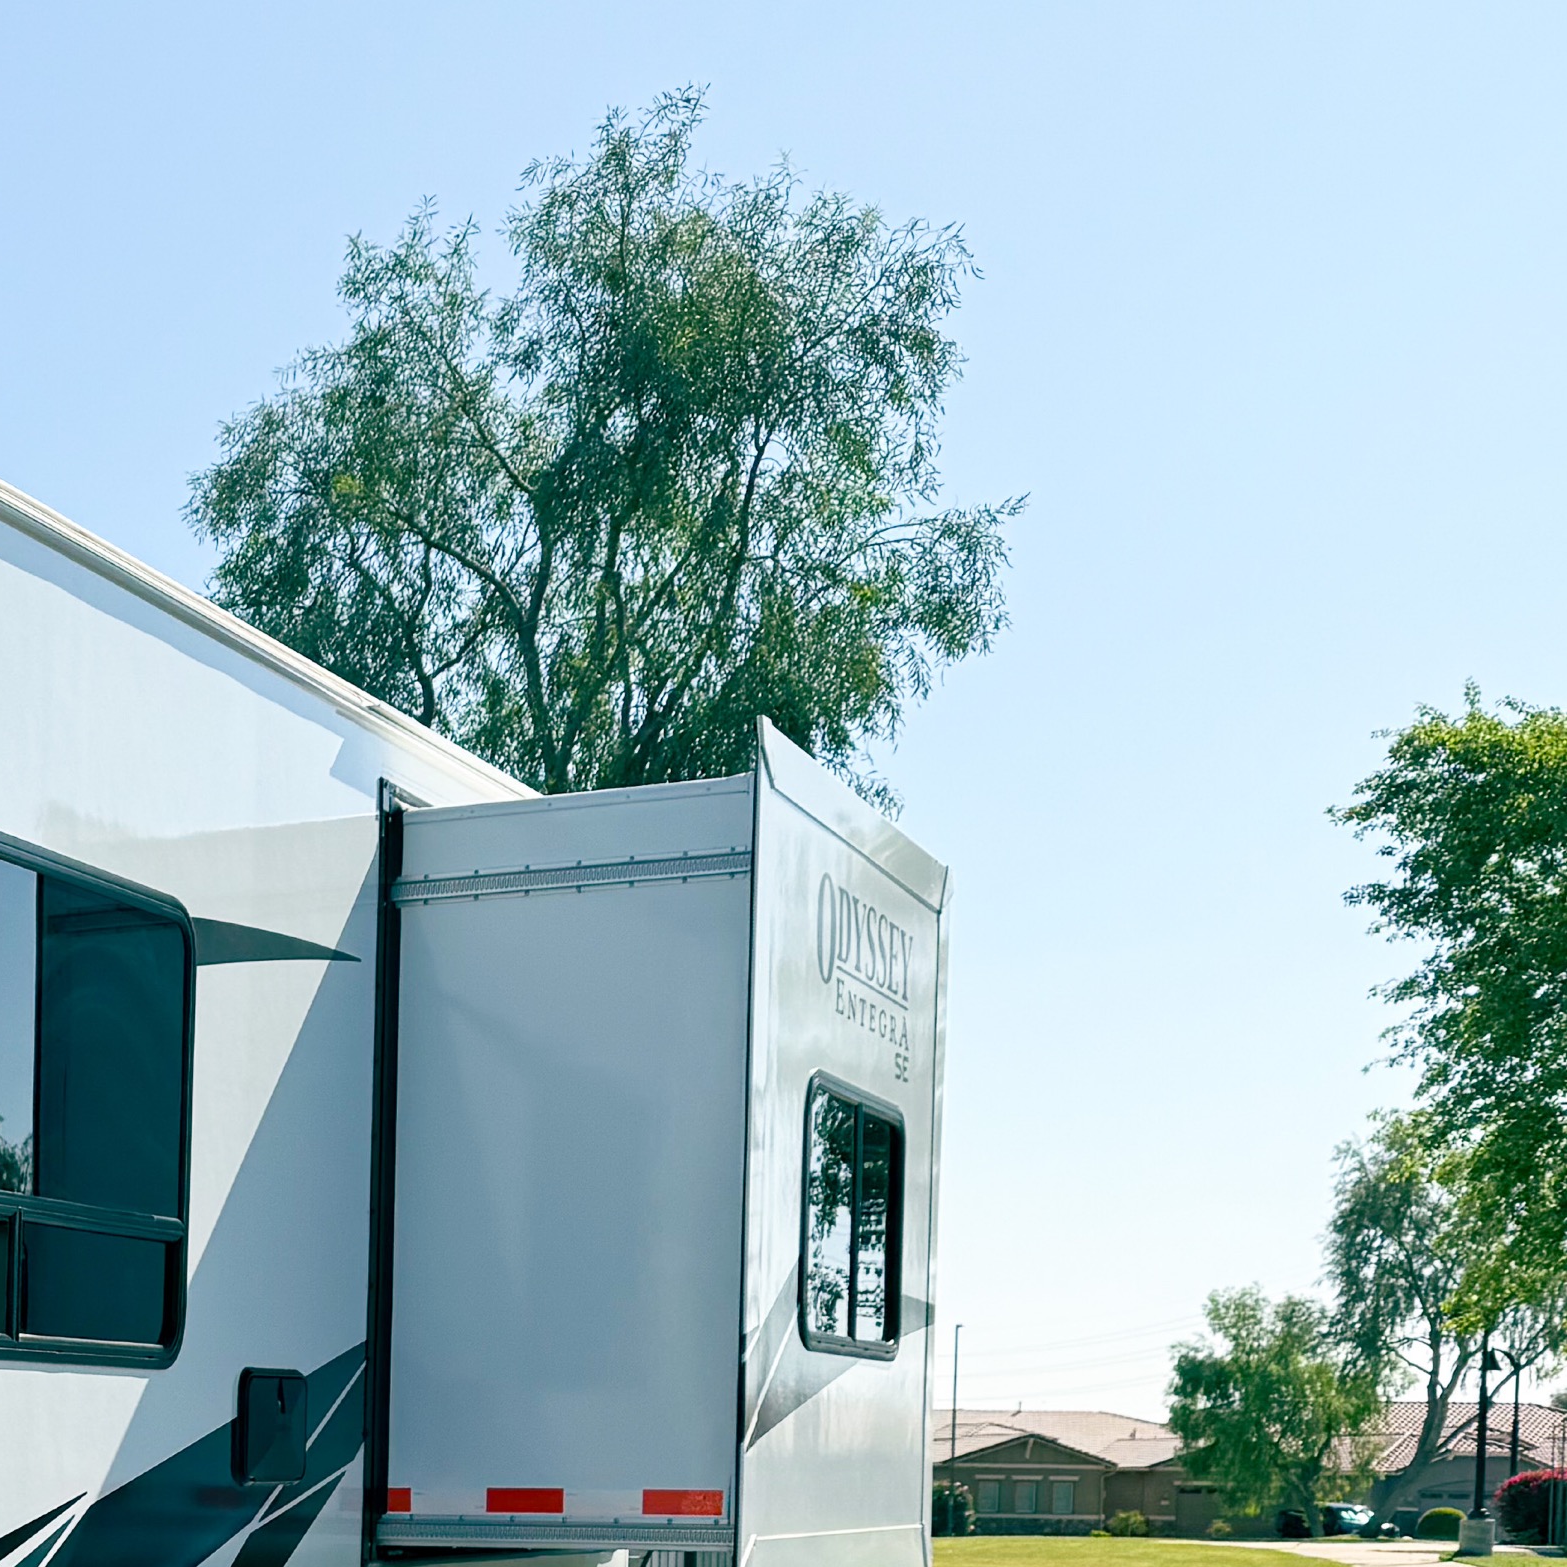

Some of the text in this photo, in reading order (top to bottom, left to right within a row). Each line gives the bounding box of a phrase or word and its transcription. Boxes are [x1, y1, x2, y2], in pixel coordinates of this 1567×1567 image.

[817, 872, 913, 1002] ODYSSEY
[835, 977, 910, 1051] ENTEGRA
[894, 1052, 909, 1083] SE
